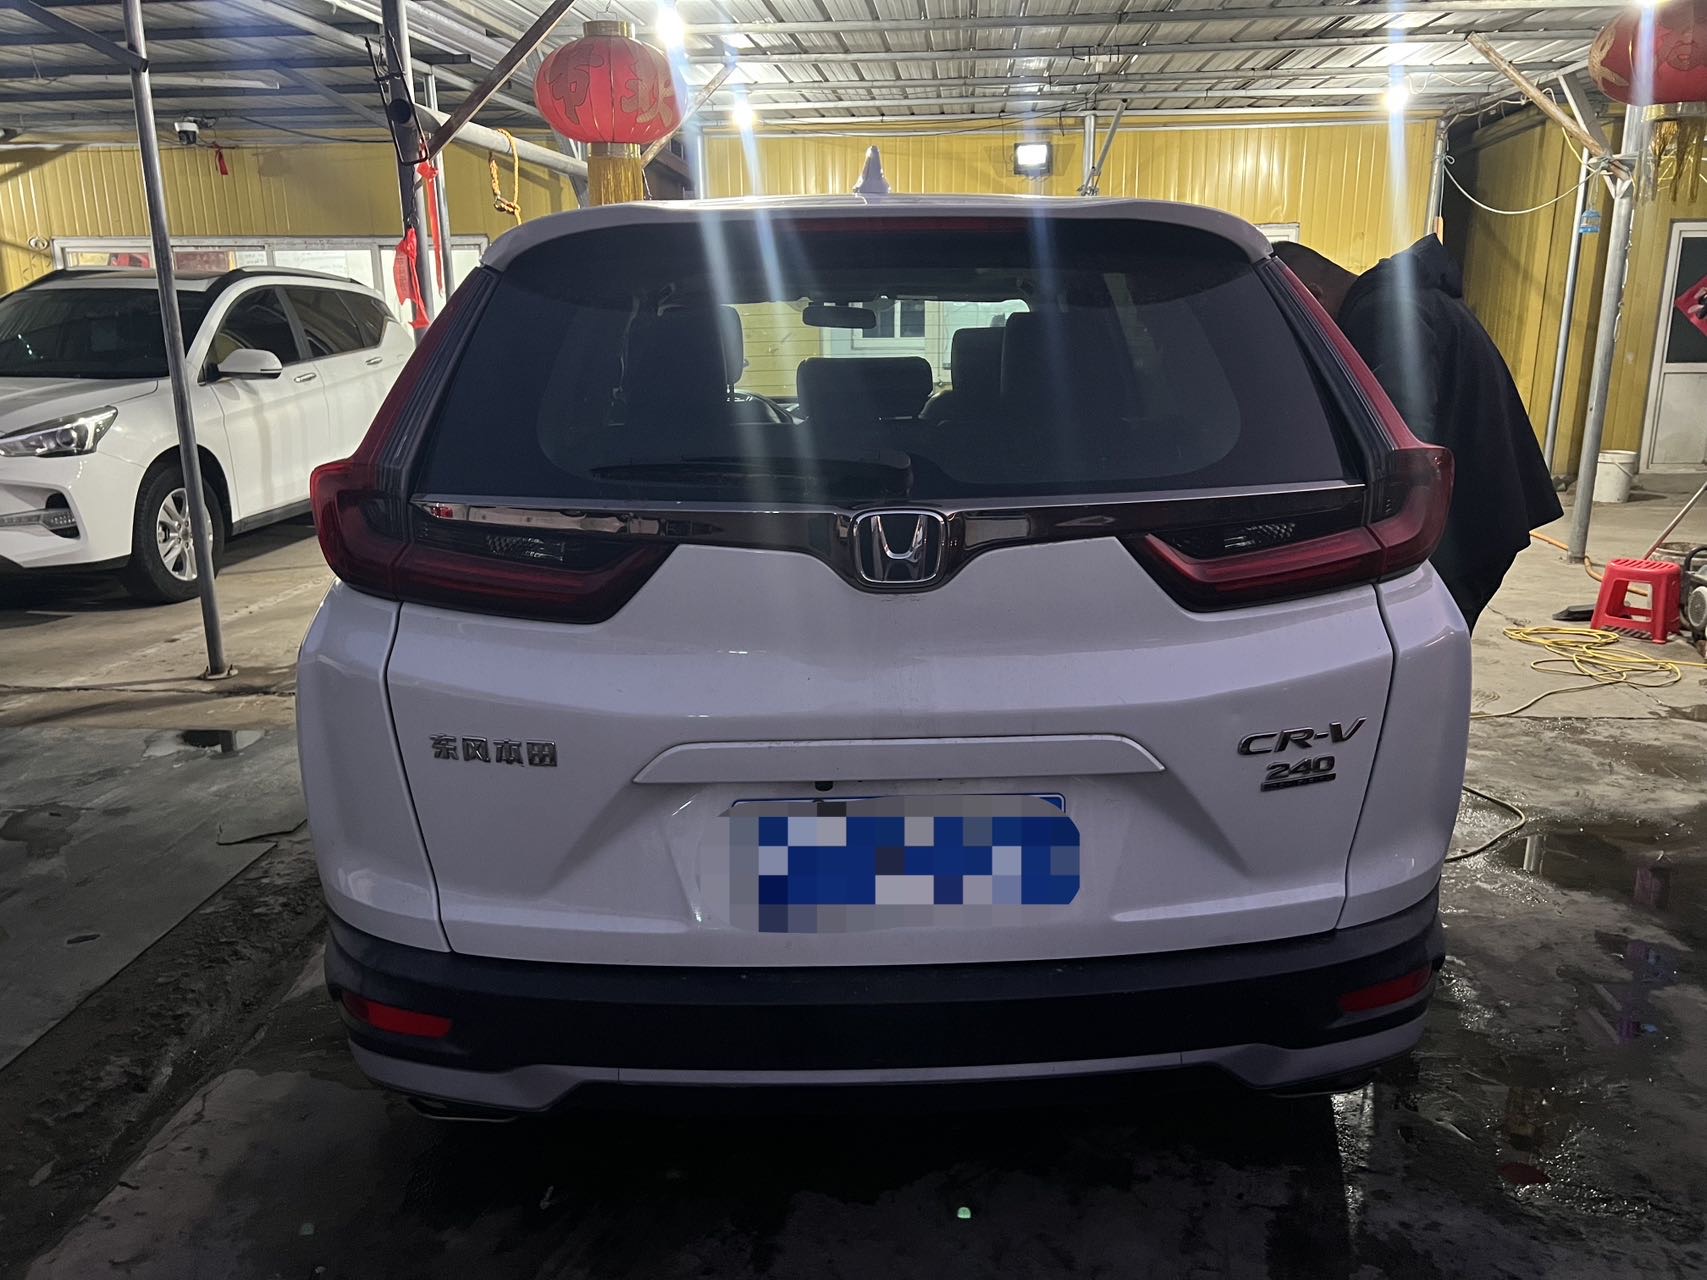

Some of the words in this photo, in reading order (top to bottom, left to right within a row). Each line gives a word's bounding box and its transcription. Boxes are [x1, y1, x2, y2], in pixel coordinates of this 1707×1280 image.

[429, 733, 558, 767] 东风本田
[1237, 717, 1367, 755] CR-V
[1265, 754, 1335, 781] 240
